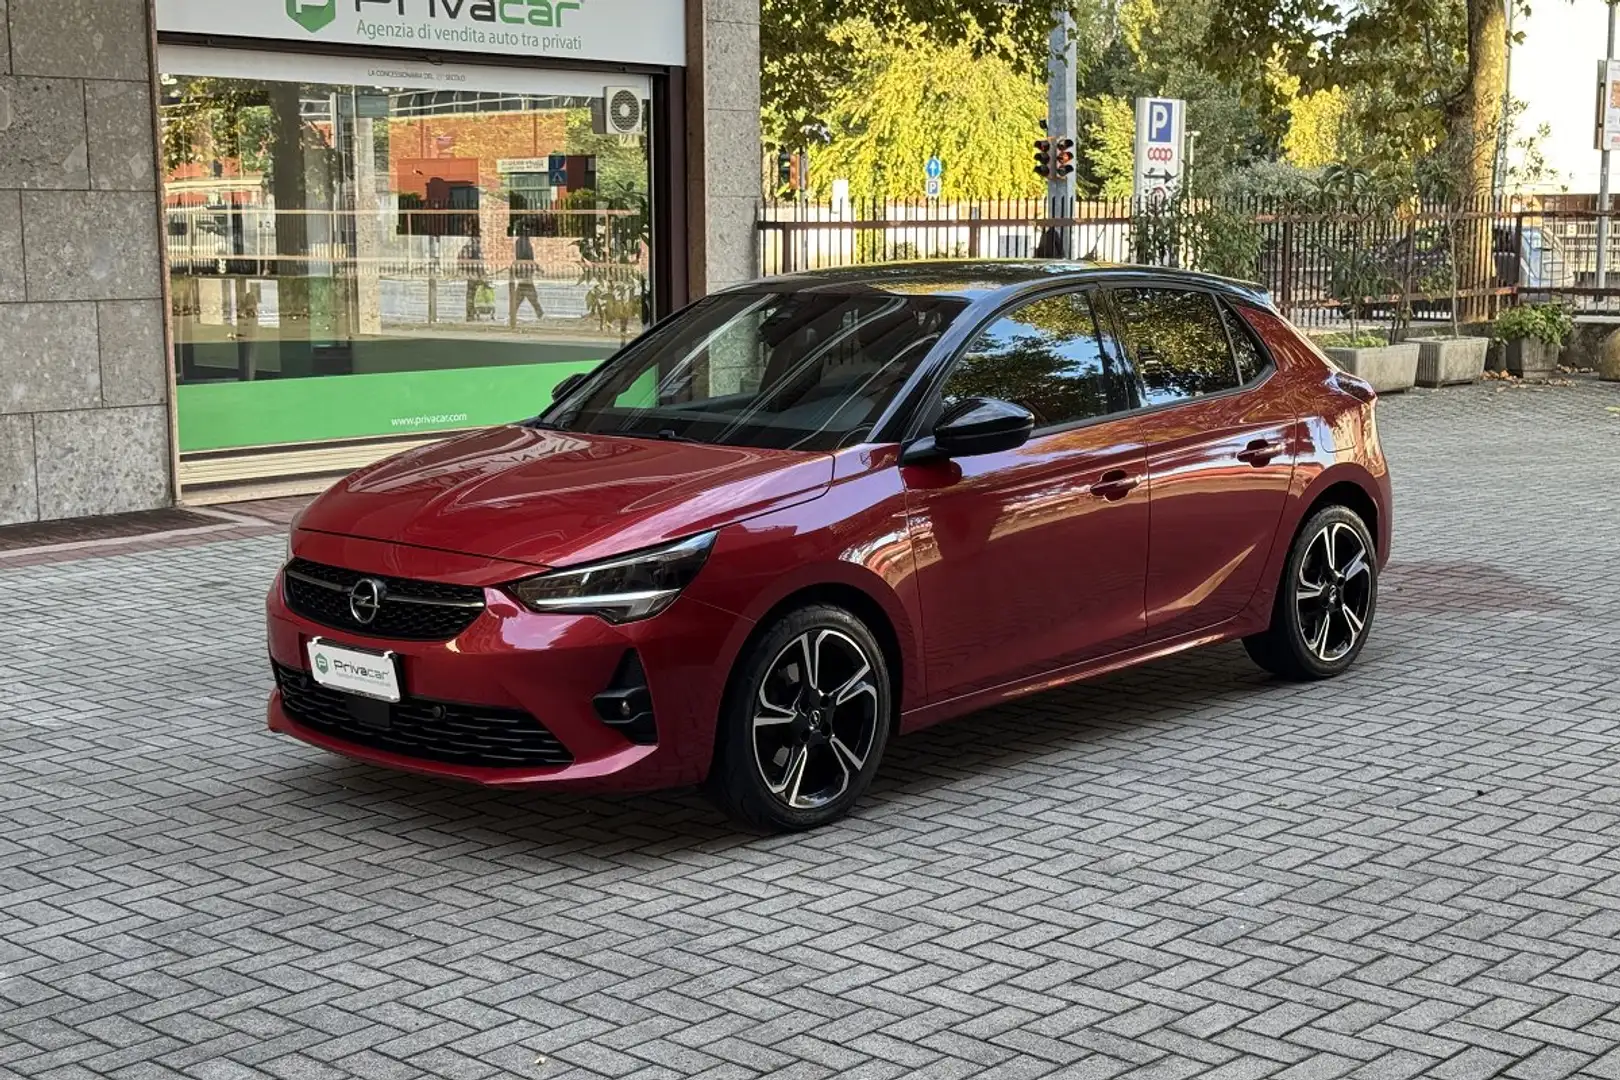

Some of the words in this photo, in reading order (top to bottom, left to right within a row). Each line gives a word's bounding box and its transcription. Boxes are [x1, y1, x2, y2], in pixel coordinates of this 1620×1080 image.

[356, 19, 414, 39] Agenzia
[418, 24, 431, 40] di
[434, 27, 485, 43] vendita
[489, 32, 519, 46] auto
[521, 34, 539, 47] tra
[542, 36, 582, 51] privati
[1151, 105, 1168, 139] P
[391, 413, 467, 426] www.privacar.com
[333, 660, 390, 680] Privacar
